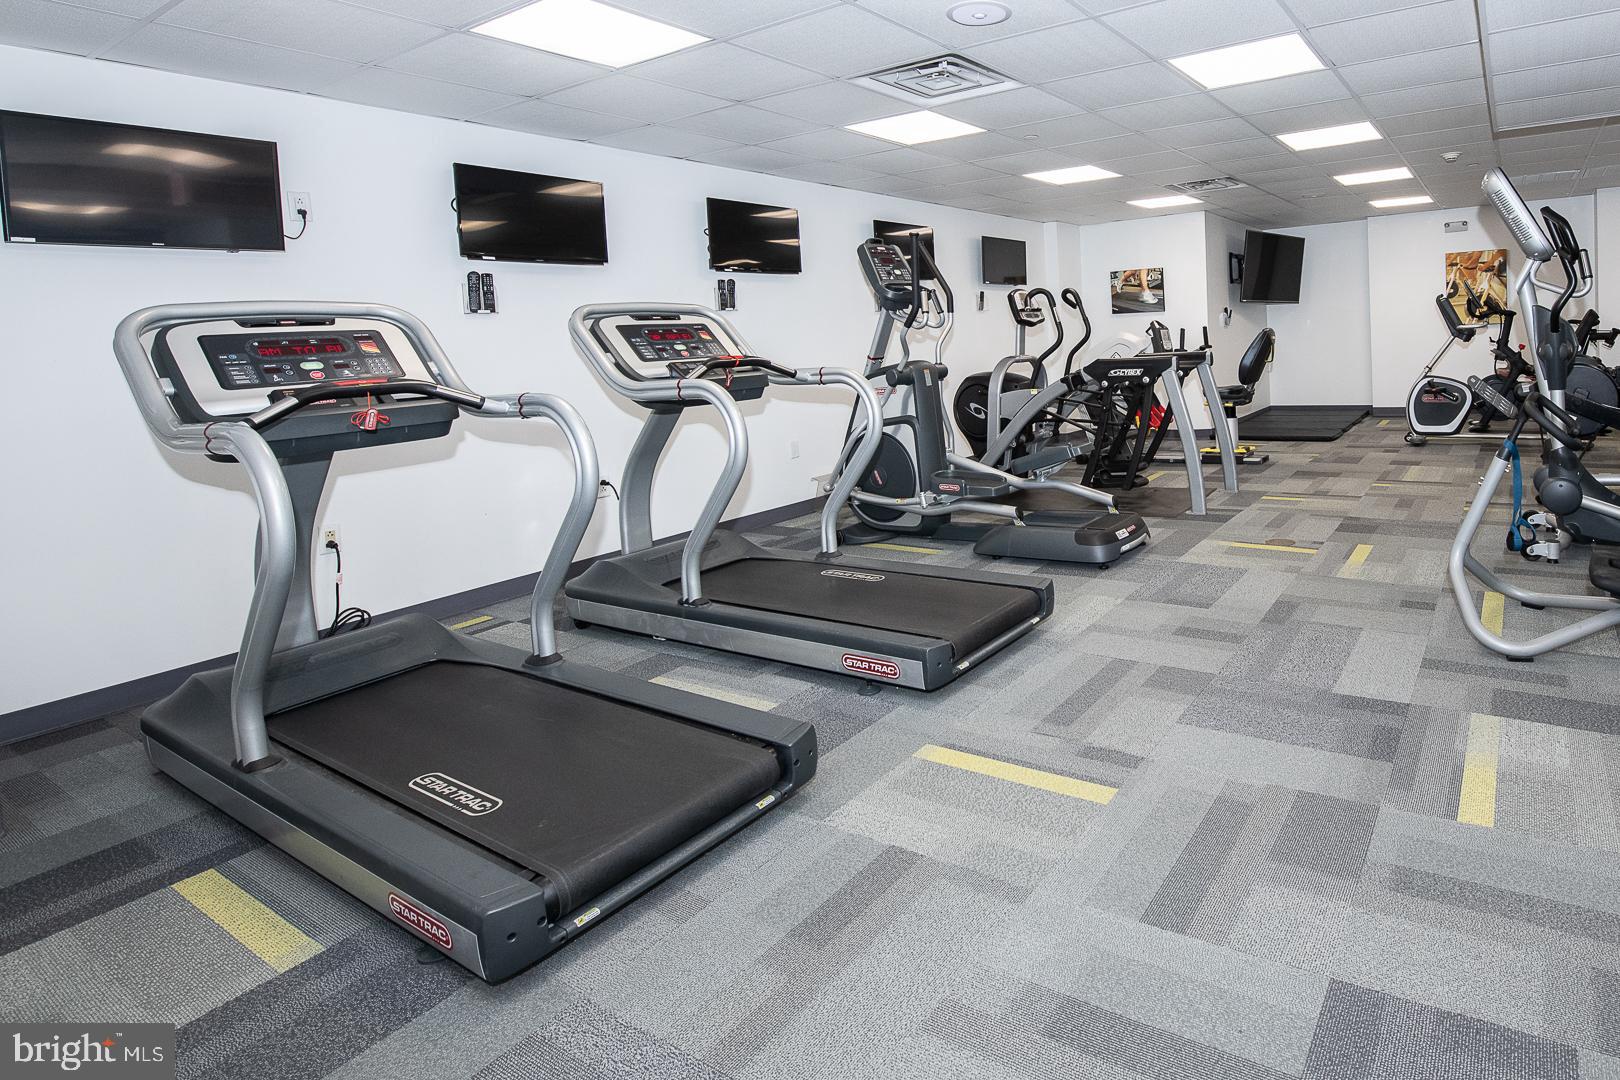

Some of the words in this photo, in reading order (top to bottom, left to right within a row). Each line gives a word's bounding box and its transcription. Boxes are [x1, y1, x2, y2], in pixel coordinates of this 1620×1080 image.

[845, 659, 869, 669] STAR
[869, 663, 895, 674] TRAC
[416, 776, 458, 795] STAR
[449, 790, 493, 811] TRAC
[391, 901, 418, 923] STAR
[418, 916, 447, 941] TRAC
